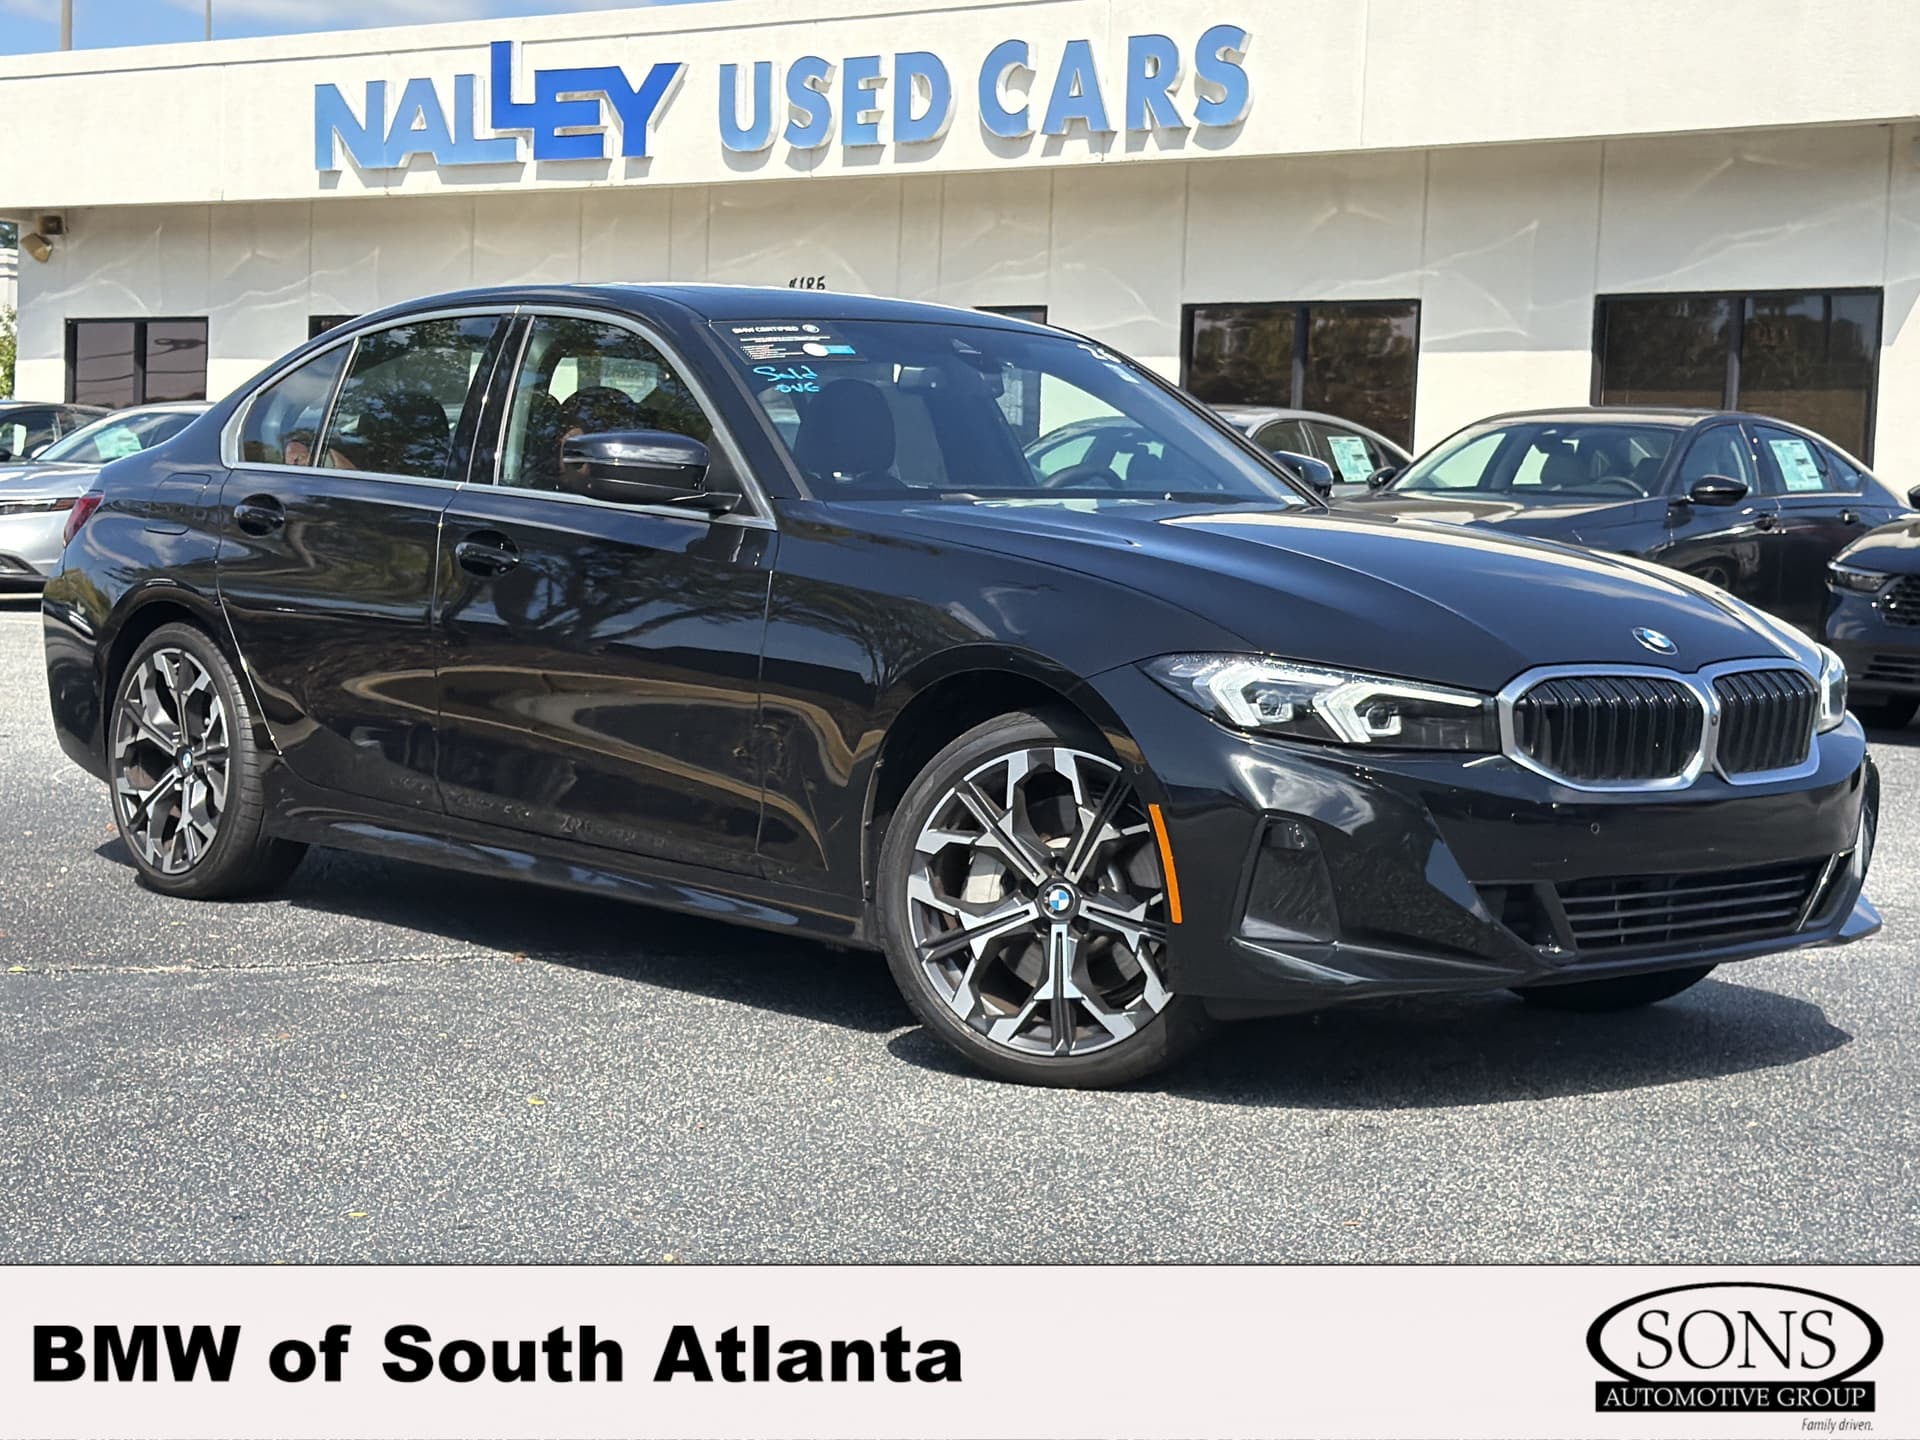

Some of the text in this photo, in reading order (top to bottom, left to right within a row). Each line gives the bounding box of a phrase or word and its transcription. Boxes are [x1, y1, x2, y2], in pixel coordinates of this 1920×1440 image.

[314, 24, 1253, 170] NALLEY USED CARS
